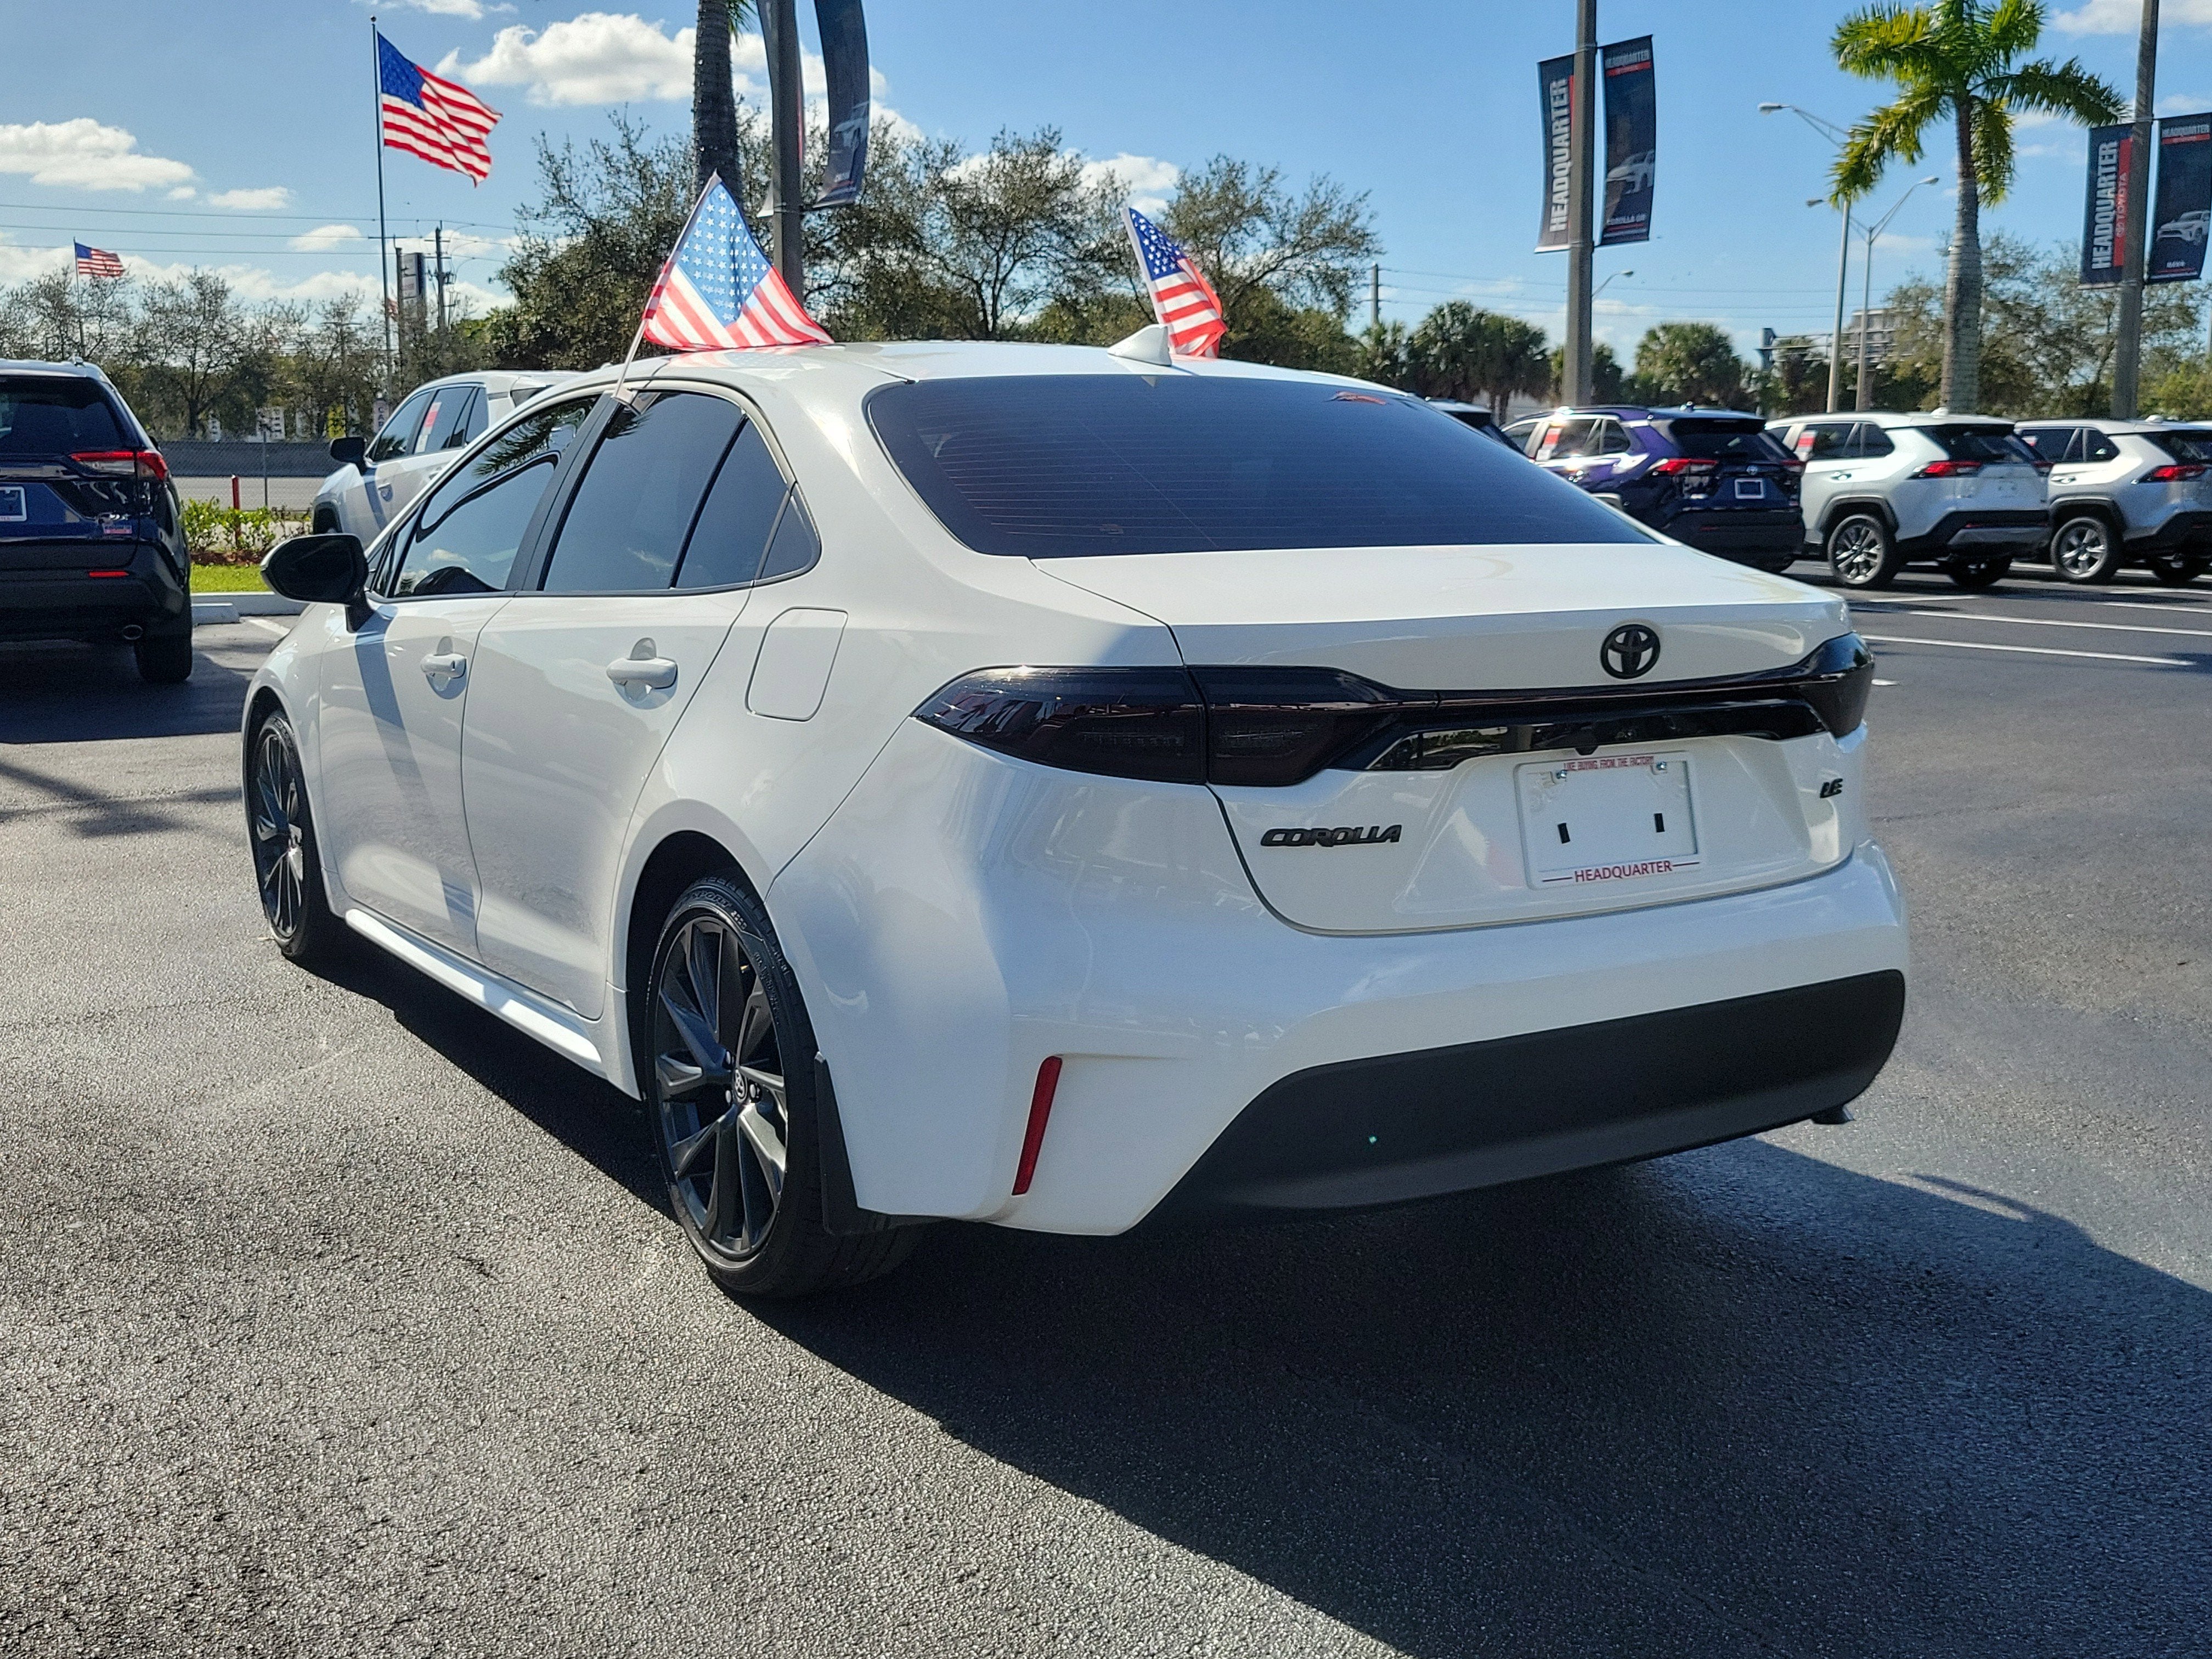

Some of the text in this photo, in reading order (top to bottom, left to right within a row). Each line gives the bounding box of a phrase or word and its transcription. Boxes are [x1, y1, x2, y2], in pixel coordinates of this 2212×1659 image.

[1549, 78, 1571, 232] HEADQUARTER
[2092, 140, 2119, 269] HEADQUARTER
[1820, 778, 1843, 799] LE
[1260, 824, 1402, 848] COROLLA
[1575, 860, 1673, 883] HEADQUARTER
